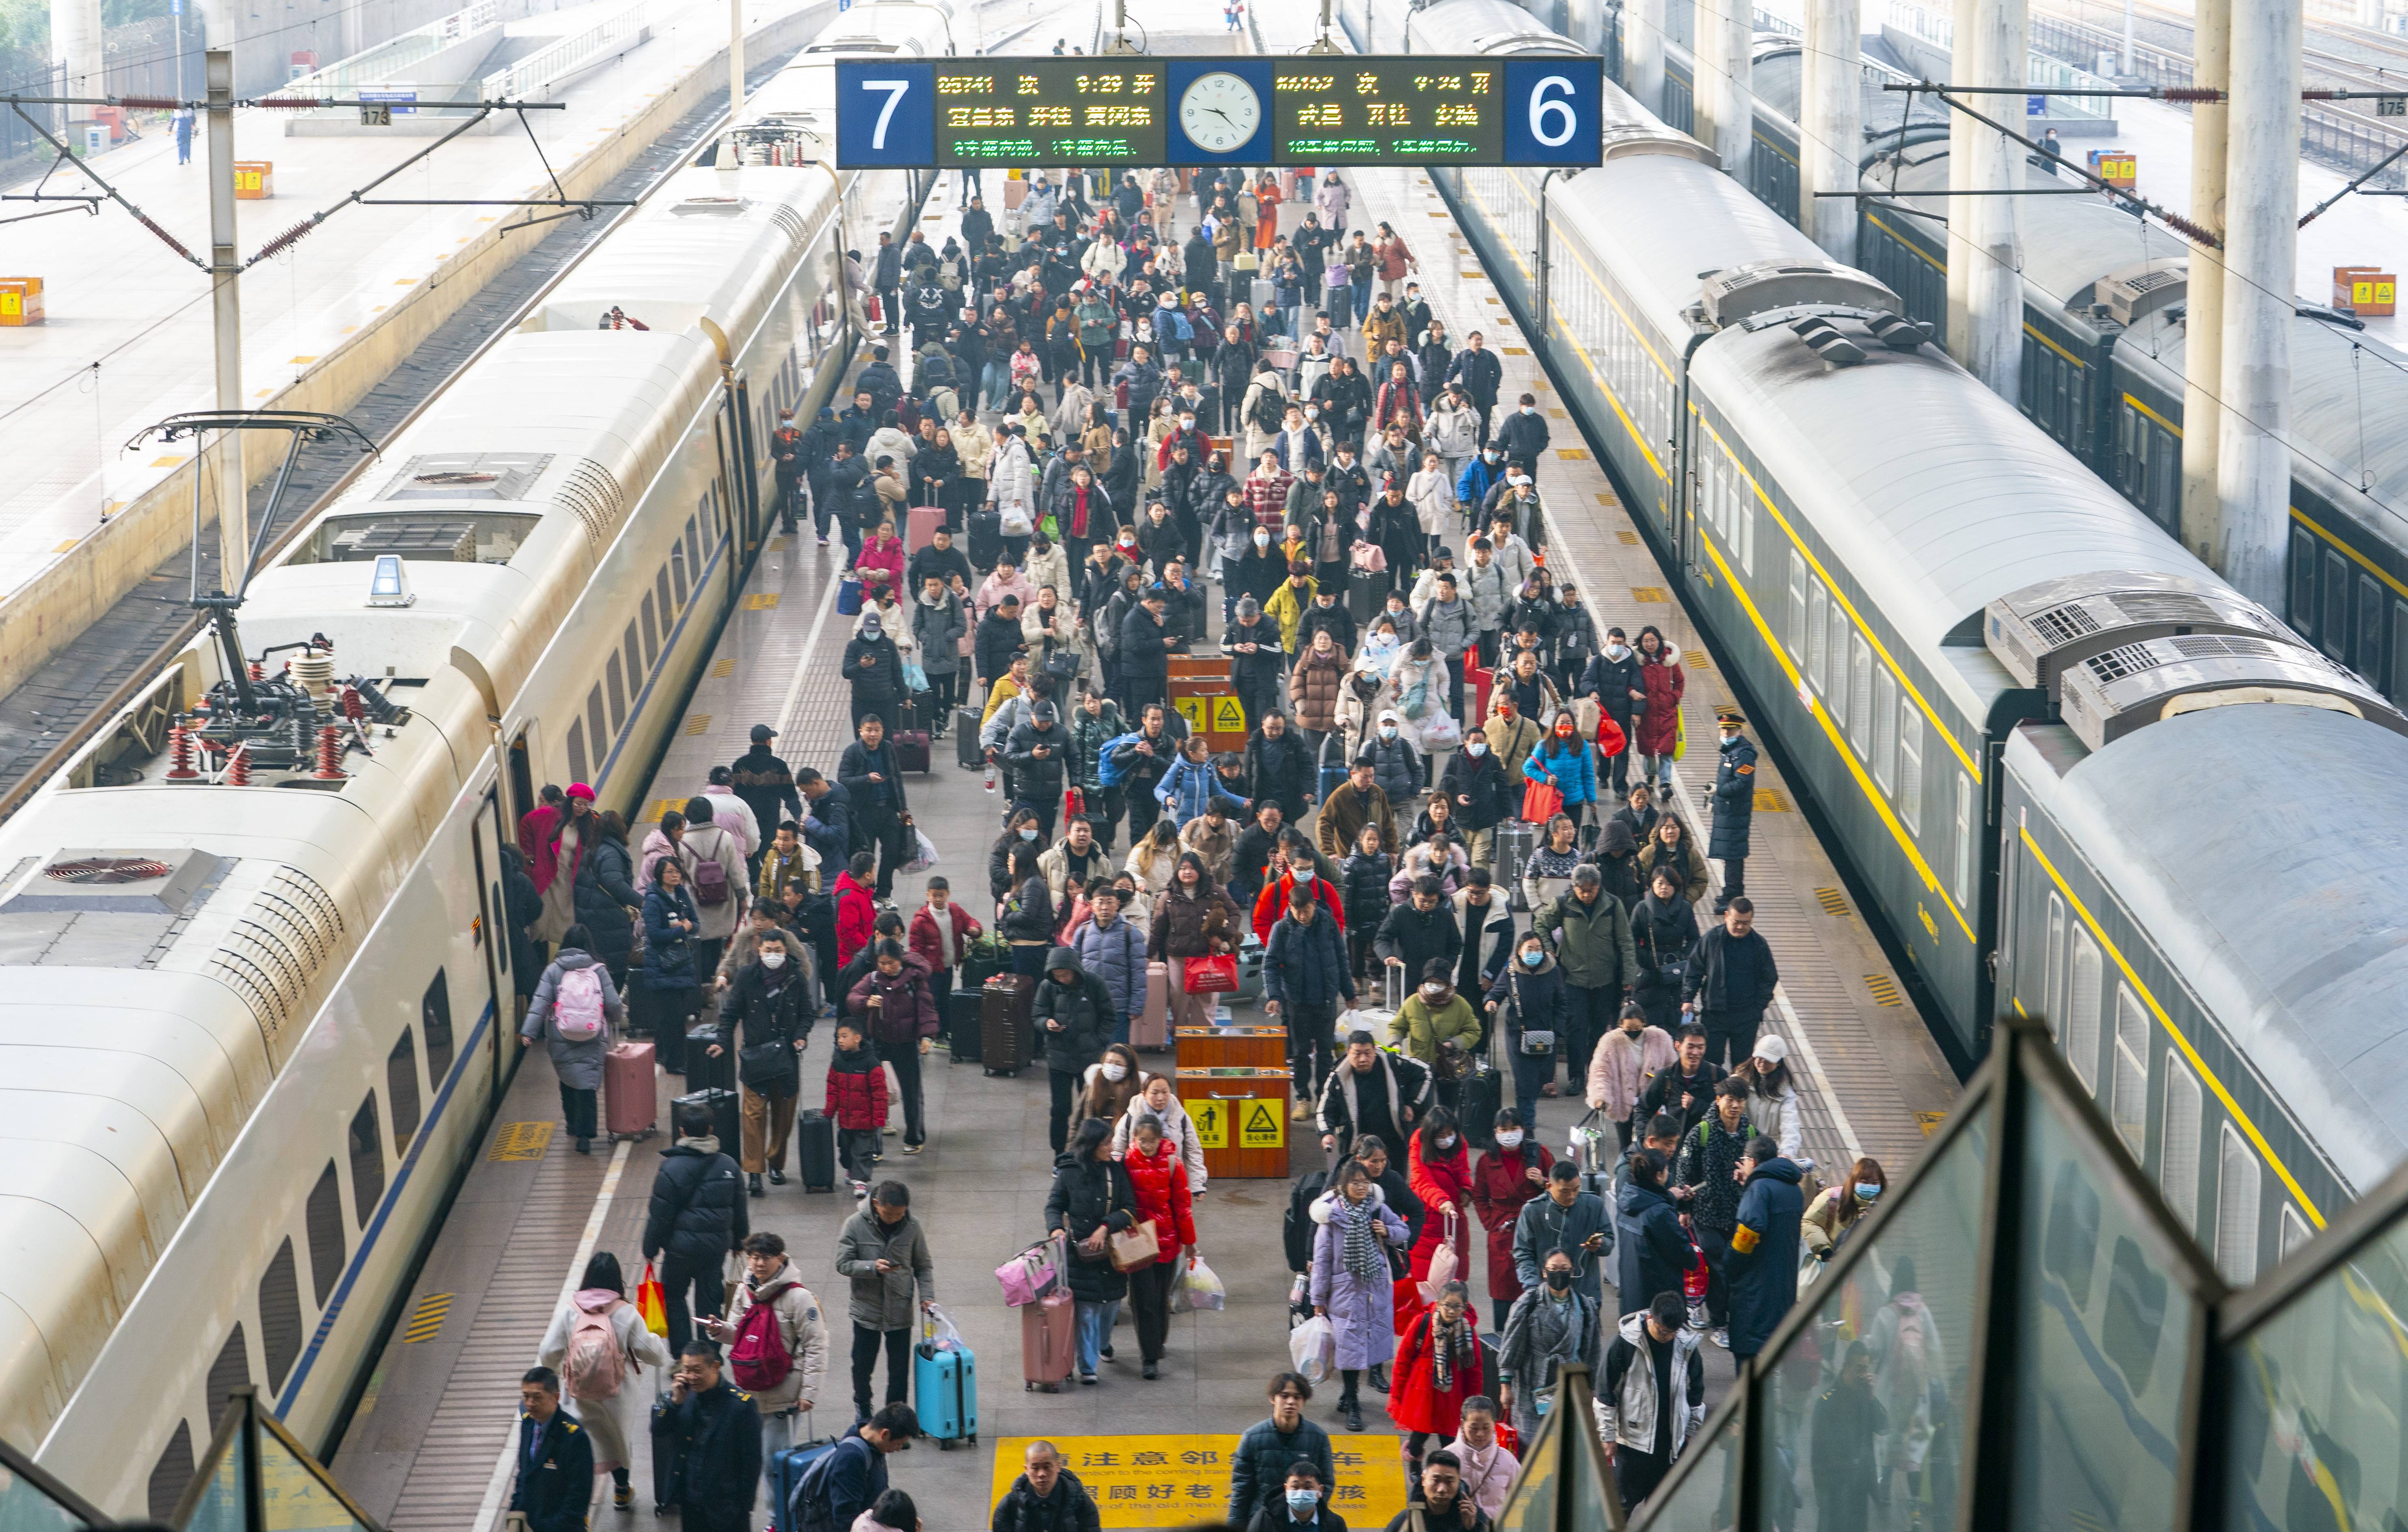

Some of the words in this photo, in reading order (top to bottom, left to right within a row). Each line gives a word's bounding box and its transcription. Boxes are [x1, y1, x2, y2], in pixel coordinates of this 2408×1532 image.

[1018, 75, 1039, 94] 次
[1076, 75, 1123, 93] 9:29
[1133, 74, 1155, 94] 开
[1215, 80, 1224, 88] 12
[1356, 72, 1379, 94] 次
[1471, 73, 1491, 94] 开
[362, 111, 388, 124] 173
[863, 80, 908, 149] 7
[948, 106, 1015, 126] 宜昌东
[1028, 106, 1072, 126] 开往
[1084, 106, 1151, 126] 黄冈东
[1366, 103, 1411, 126] 开往
[1530, 76, 1575, 146] 6
[2378, 102, 2404, 115] 175
[1216, 137, 1223, 145] 6
